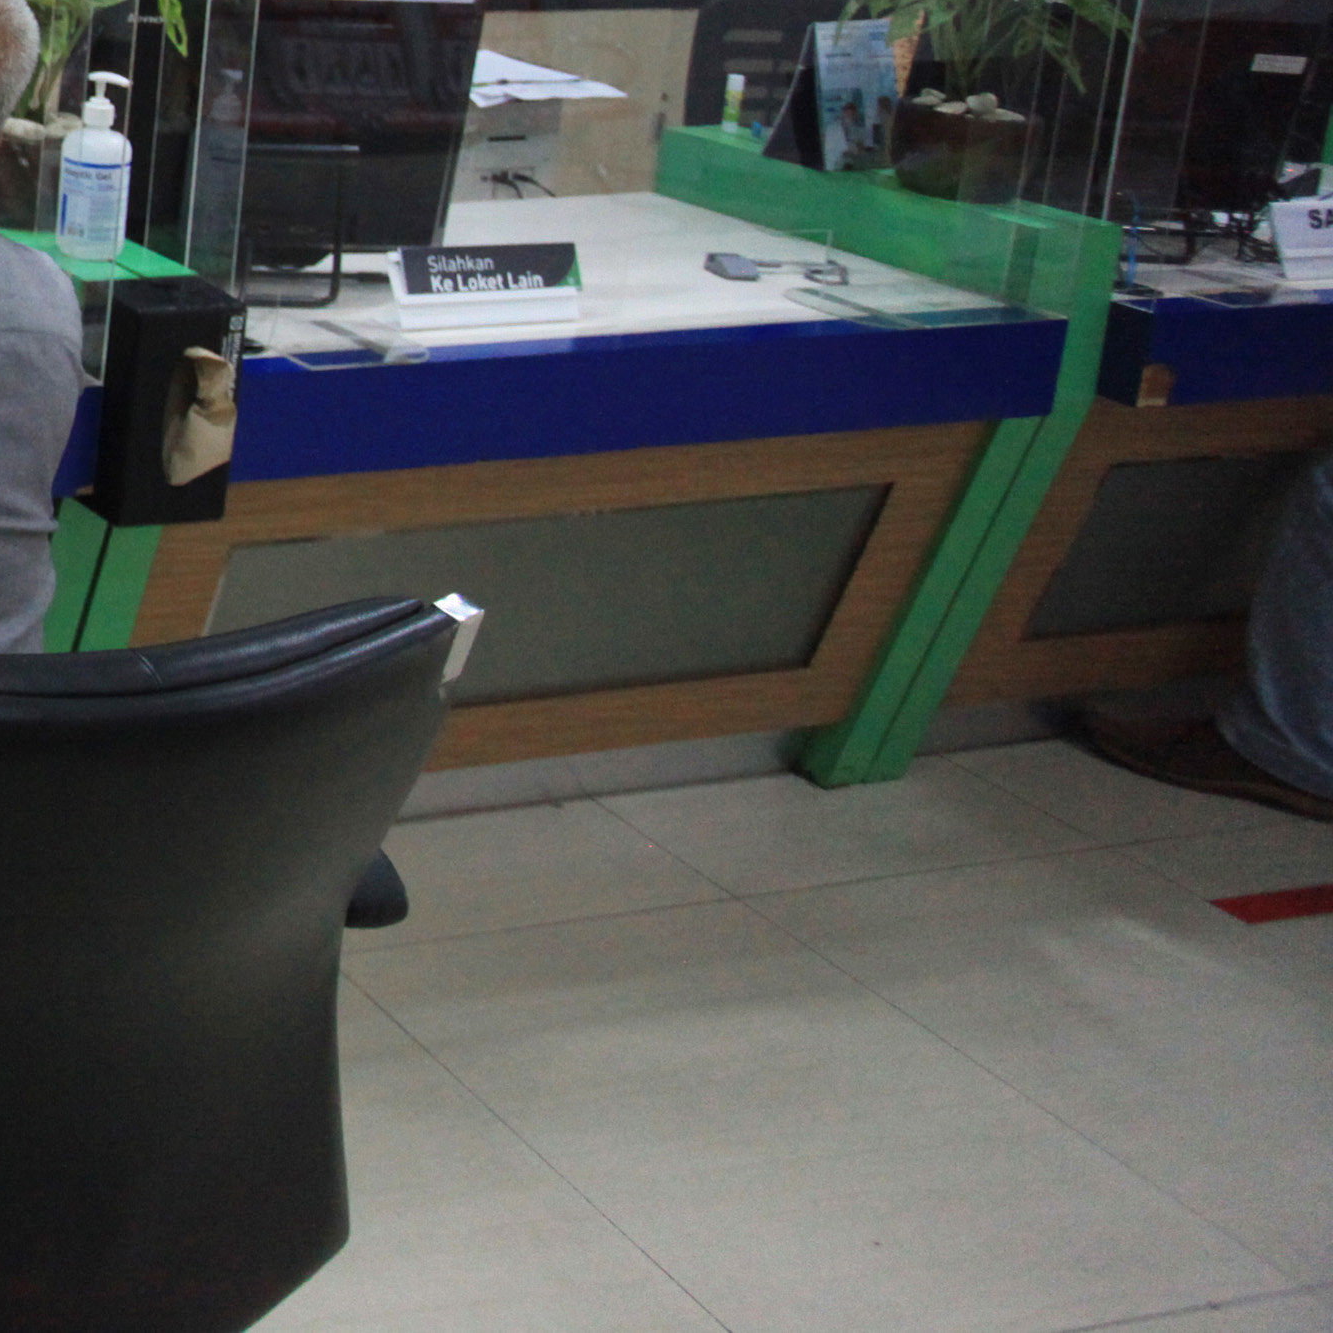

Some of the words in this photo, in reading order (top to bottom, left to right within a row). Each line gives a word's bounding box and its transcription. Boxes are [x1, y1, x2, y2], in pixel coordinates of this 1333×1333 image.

[426, 255, 494, 273] Silahkan
[430, 276, 454, 293] Ke
[456, 274, 505, 292] Loket
[508, 271, 544, 290] Lain
